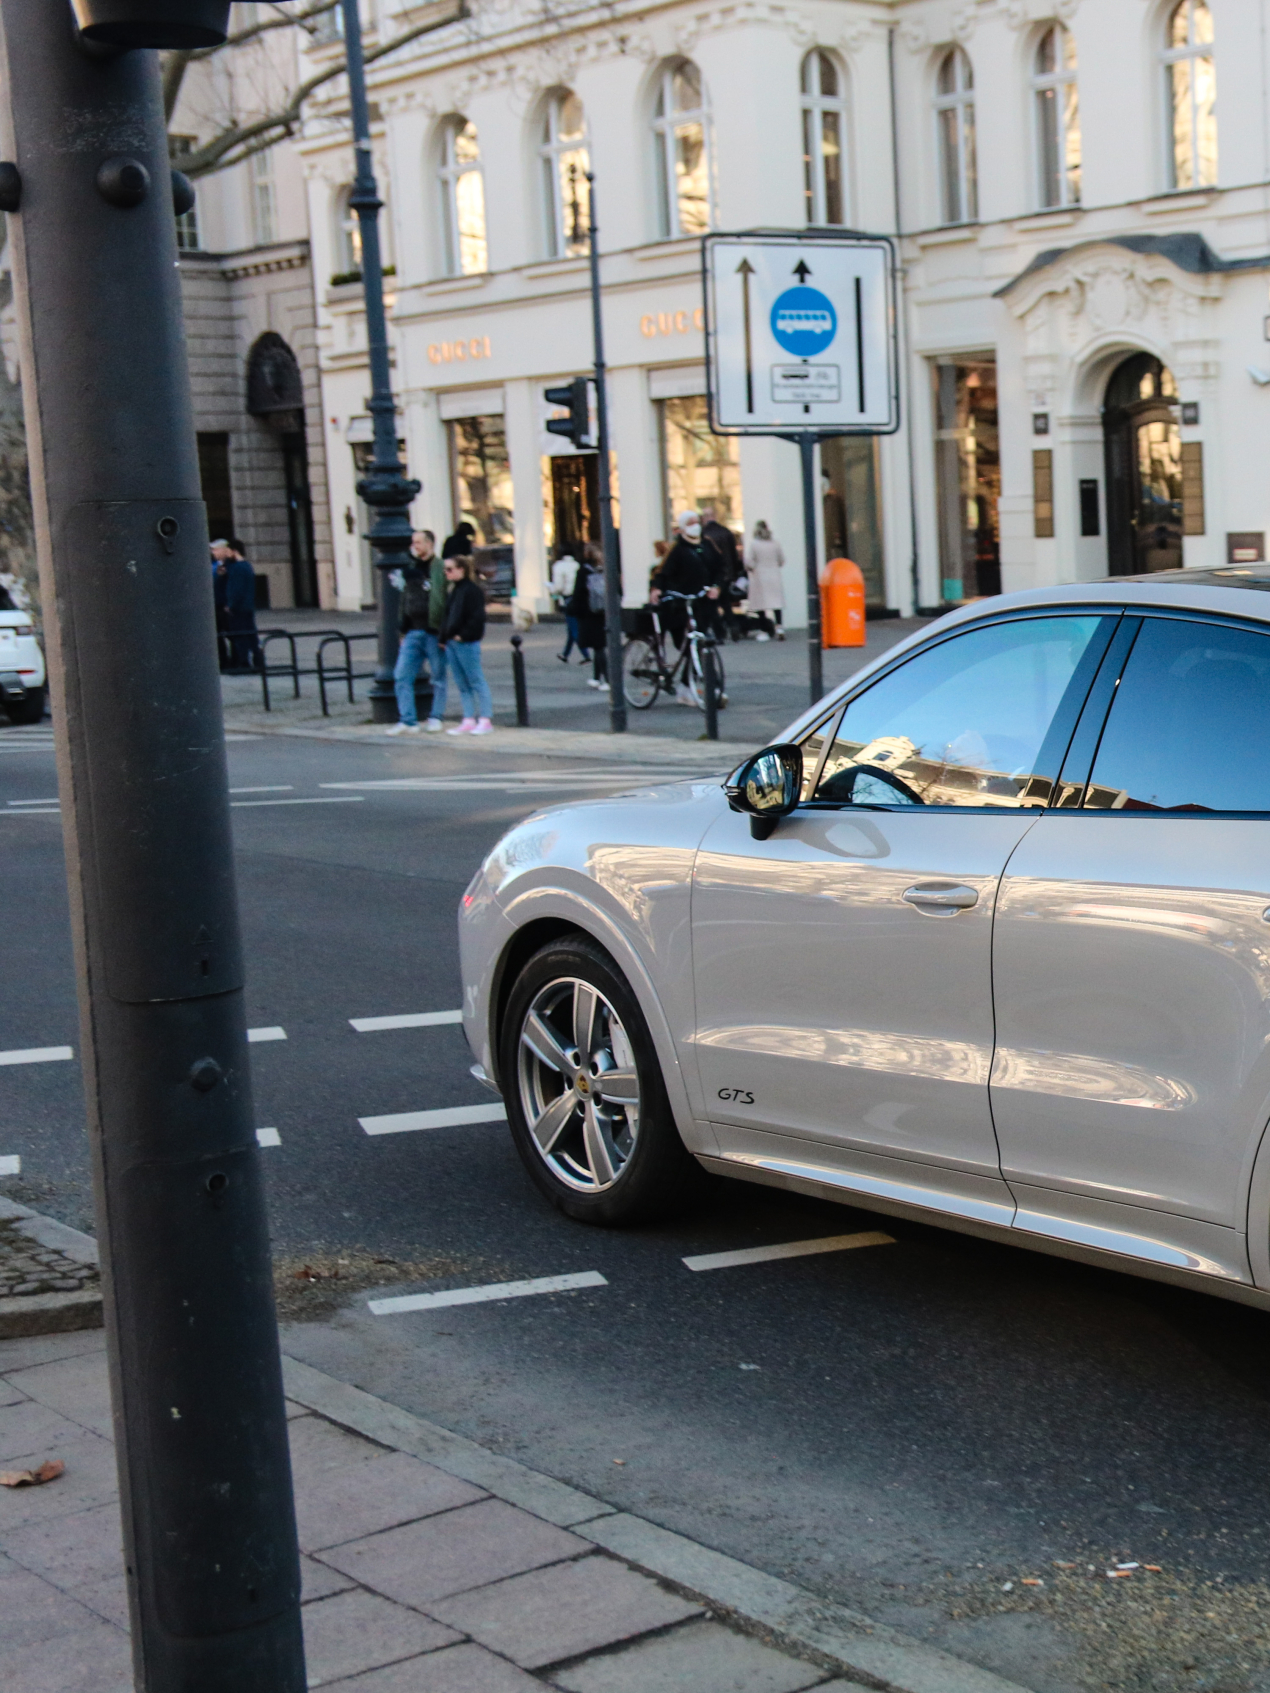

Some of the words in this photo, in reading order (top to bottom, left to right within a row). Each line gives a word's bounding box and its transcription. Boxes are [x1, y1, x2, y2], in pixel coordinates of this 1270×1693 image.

[640, 307, 705, 338] GUCC
[427, 335, 491, 366] GUCCI
[718, 1088, 755, 1104] GTS
